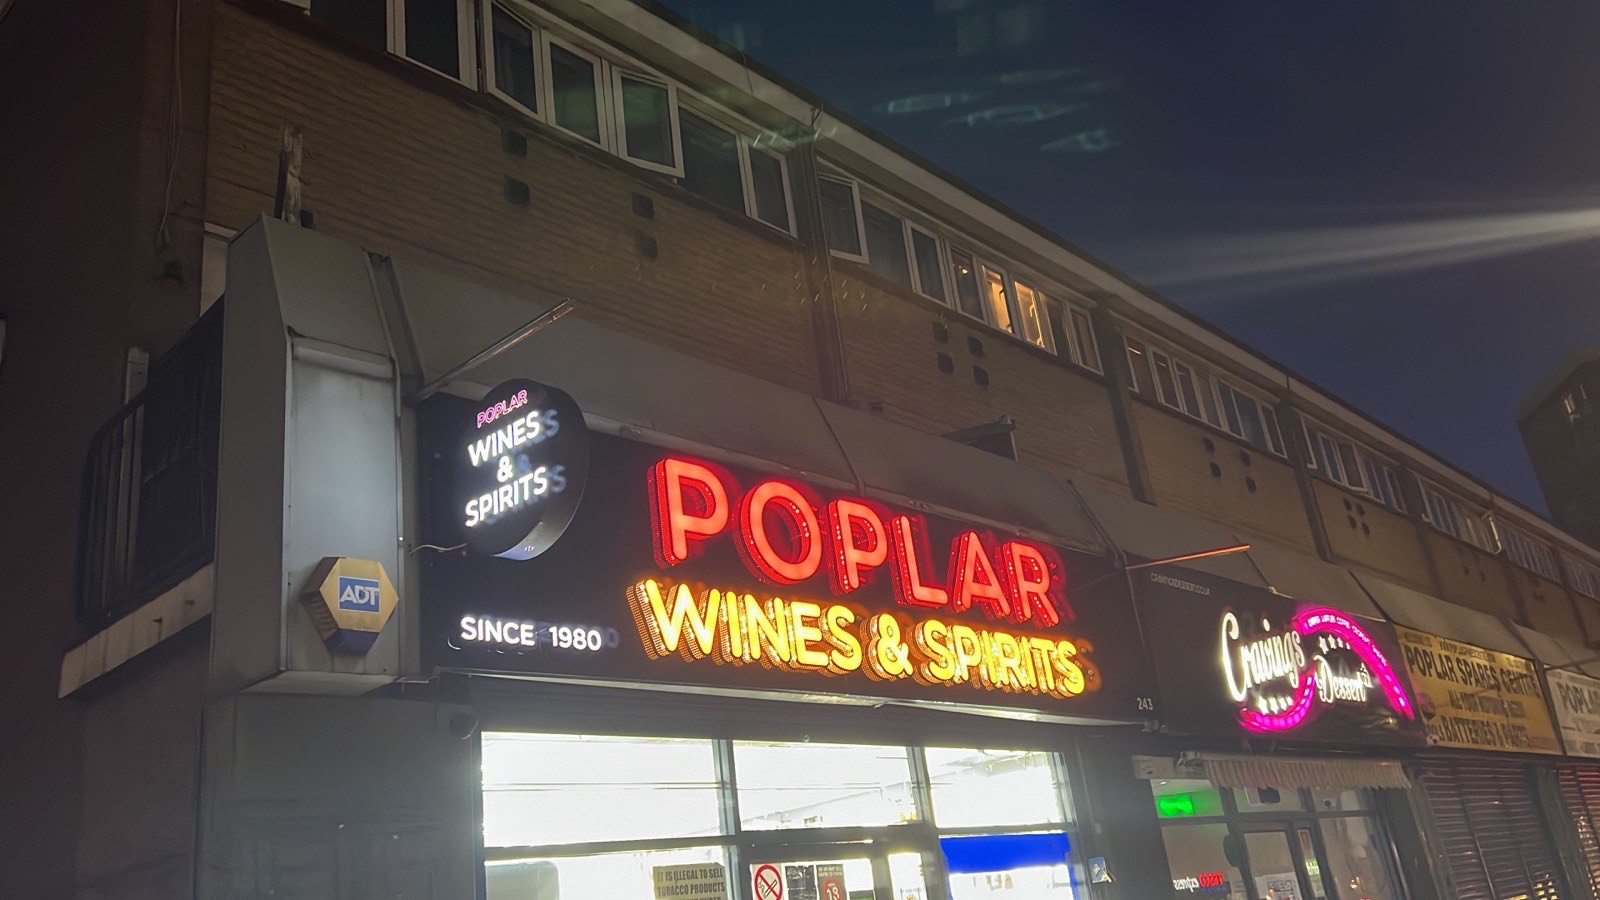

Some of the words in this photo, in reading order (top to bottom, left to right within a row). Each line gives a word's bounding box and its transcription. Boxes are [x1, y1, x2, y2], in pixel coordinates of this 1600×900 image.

[476, 389, 528, 429] POPLAR
[467, 410, 541, 468] WINES
[496, 455, 514, 484] &
[464, 466, 550, 528] SPIRITS
[652, 457, 1062, 627] POPLAR
[340, 584, 380, 606] ADT
[460, 615, 536, 647] SINCE
[548, 626, 602, 652] 1980
[634, 578, 863, 674] WINES
[868, 612, 914, 681] &
[920, 619, 1087, 697] SPIRITS
[1221, 612, 1306, 703] Cravings
[1313, 654, 1368, 704] Dessert
[1403, 645, 1459, 683] POPLAR
[1456, 656, 1502, 692] SPARES
[1136, 697, 1154, 711] 243
[657, 872, 665, 883] IT
[665, 871, 673, 882] IS
[673, 869, 699, 882] ILLEGAL
[699, 869, 708, 880] TO
[708, 867, 724, 879] SELL
[657, 884, 689, 898] TOBACCO
[690, 881, 726, 895] PRODUCTS
